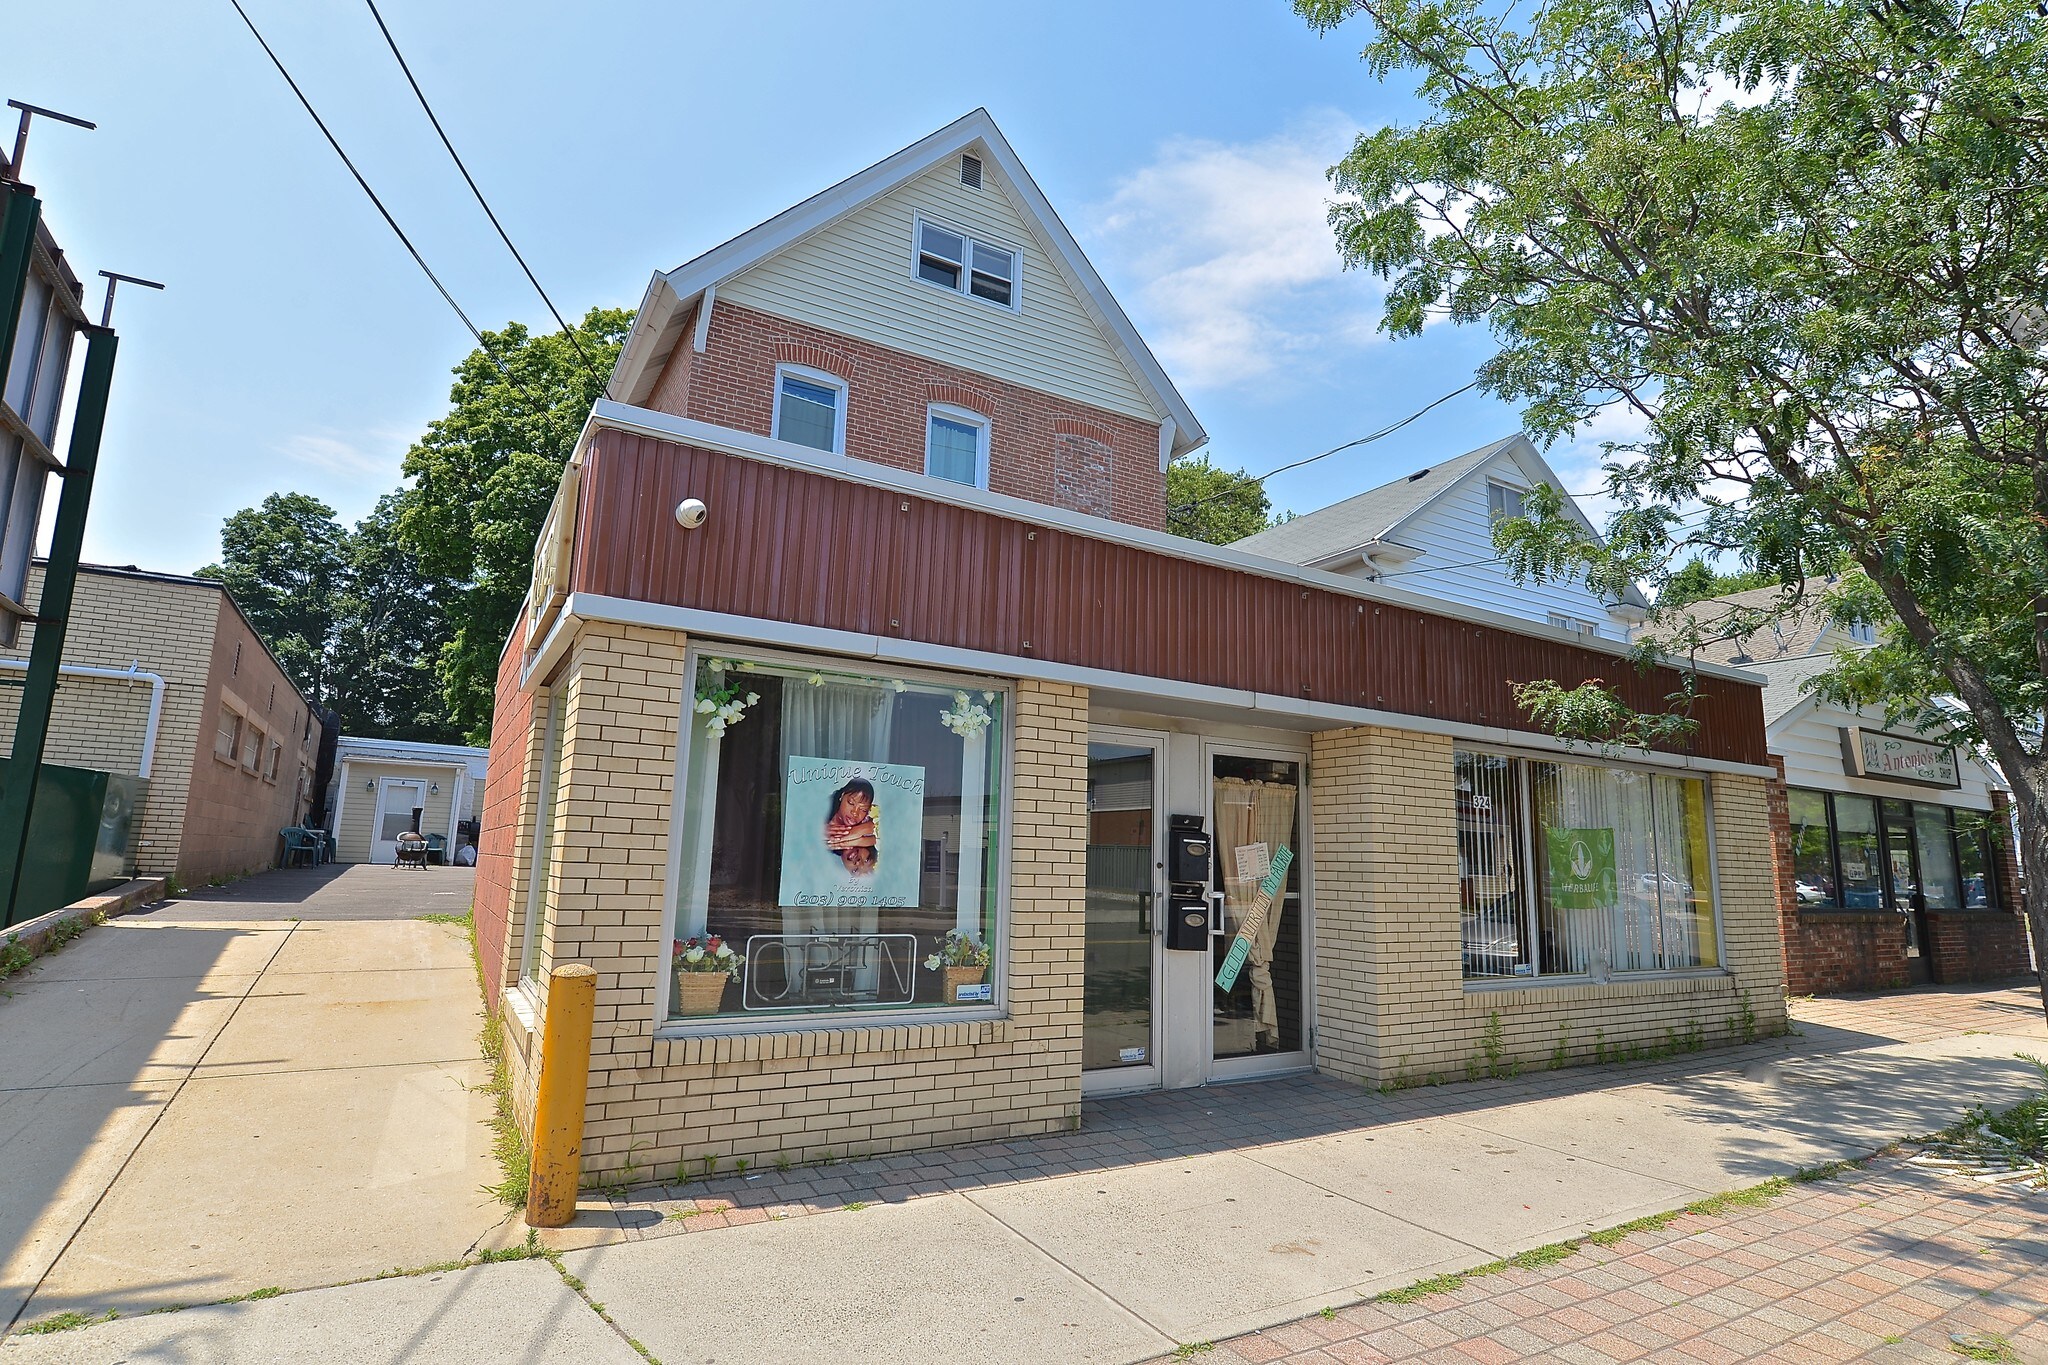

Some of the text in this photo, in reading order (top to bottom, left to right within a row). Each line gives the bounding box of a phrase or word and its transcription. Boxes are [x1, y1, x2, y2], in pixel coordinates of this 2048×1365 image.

[1883, 748, 1953, 772] Antonio's BBER
[788, 763, 924, 795] Unique Touch
[1473, 797, 1491, 808] 324
[793, 891, 906, 907] (203) 909 1405
[1561, 882, 1599, 893] HERBALIFE
[1222, 937, 1249, 980] GOOD
[1240, 890, 1270, 941] NUTRITION
[1261, 878, 1277, 896] MY
[1271, 845, 1293, 881] FAVORITE
[753, 940, 913, 1001] OPEN
